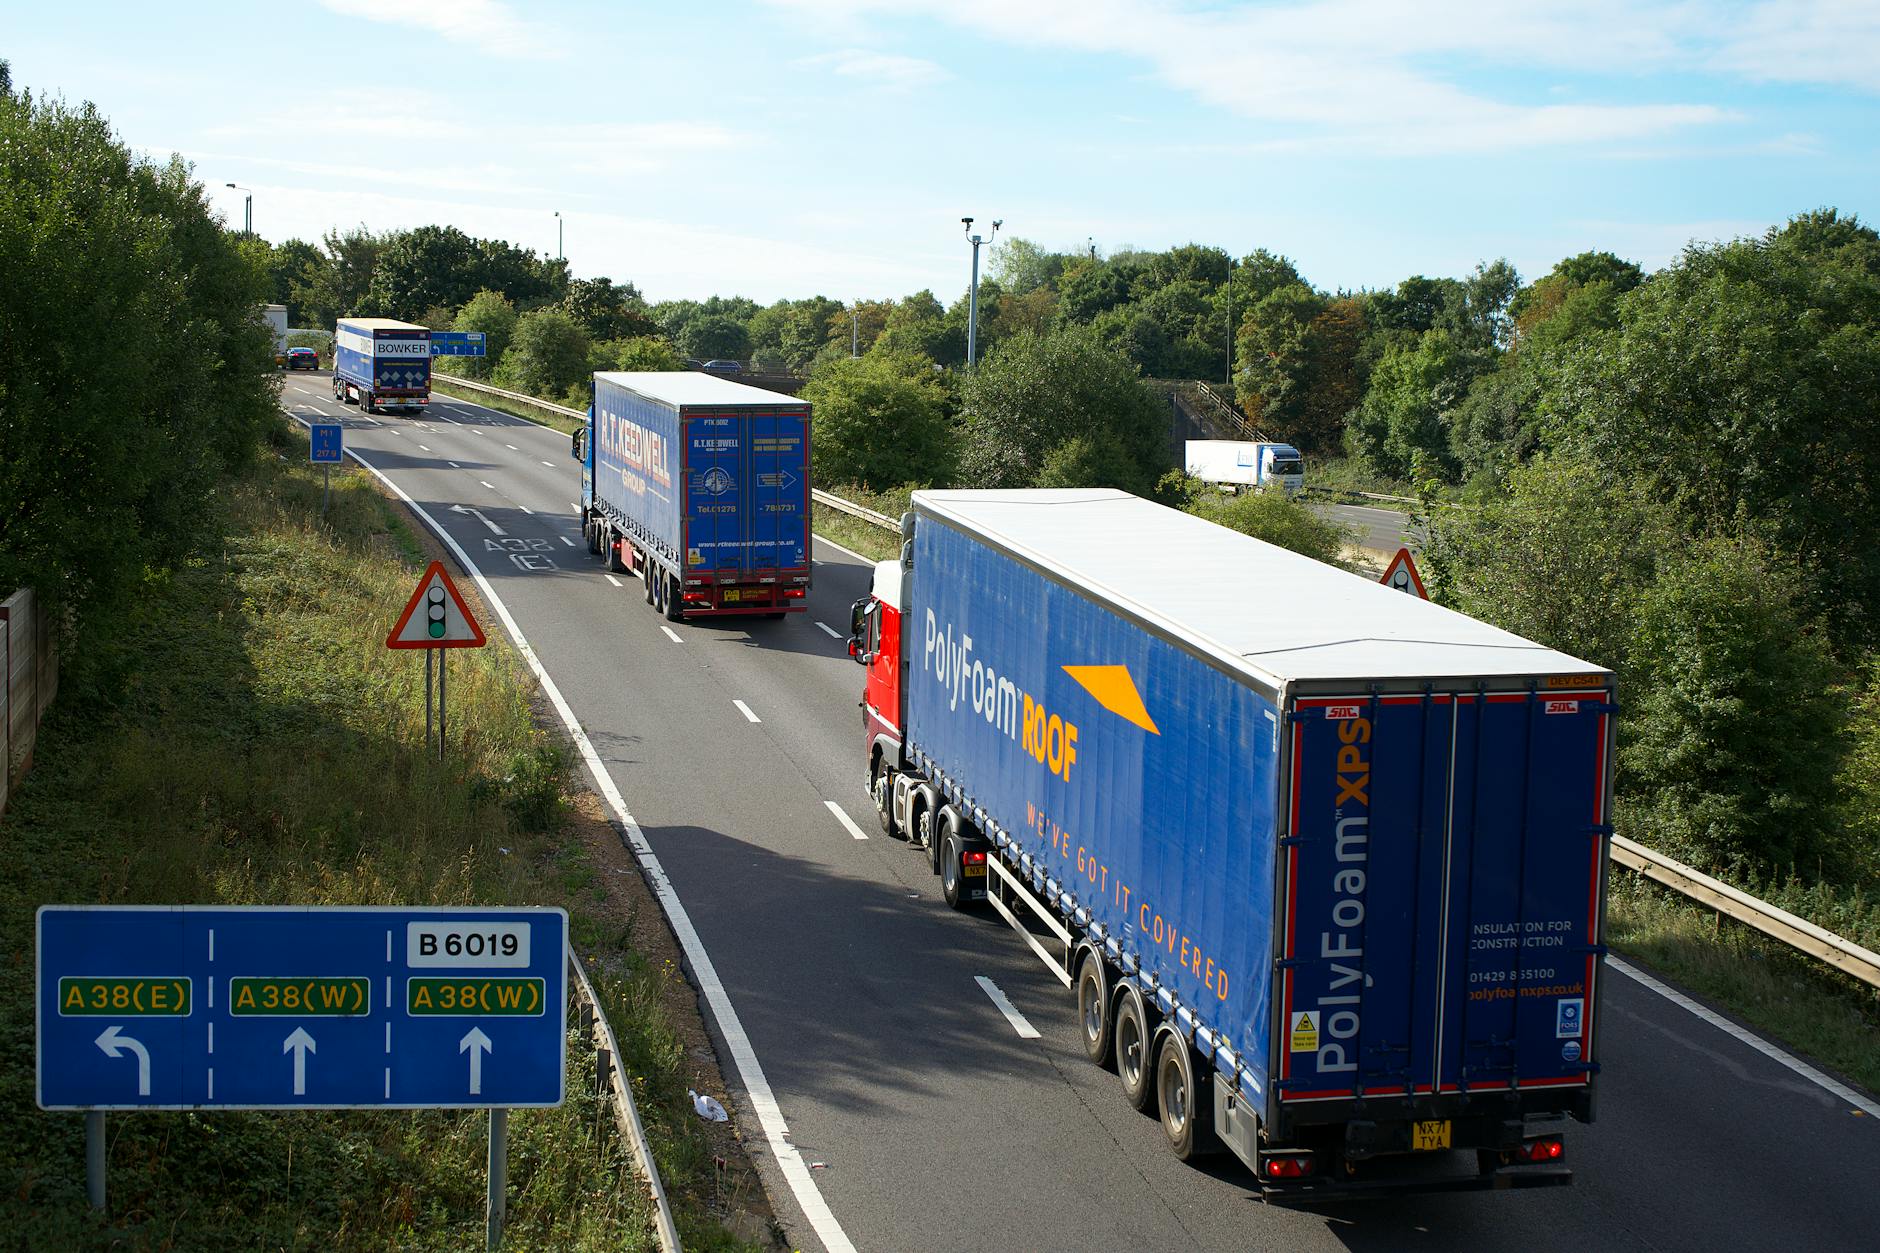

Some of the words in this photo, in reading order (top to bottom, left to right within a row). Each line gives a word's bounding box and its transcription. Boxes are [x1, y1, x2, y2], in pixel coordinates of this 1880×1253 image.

[378, 344, 427, 353] BOWKER
[693, 438, 738, 448] R.T.KEDWELL
[622, 467, 646, 496] GROUP
[1021, 692, 1078, 783] ROOF
[1335, 717, 1372, 808] XPS
[970, 866, 987, 874] NX7
[1027, 800, 1070, 858] WE'VE
[1077, 846, 1108, 893] GOT
[1115, 879, 1131, 913] IT
[1139, 903, 1229, 1001] COVERED
[1473, 922, 1544, 935] NSULATON
[1547, 920, 1572, 932] FOR
[1470, 971, 1506, 983] 01429
[1420, 1135, 1443, 1148] TYA
